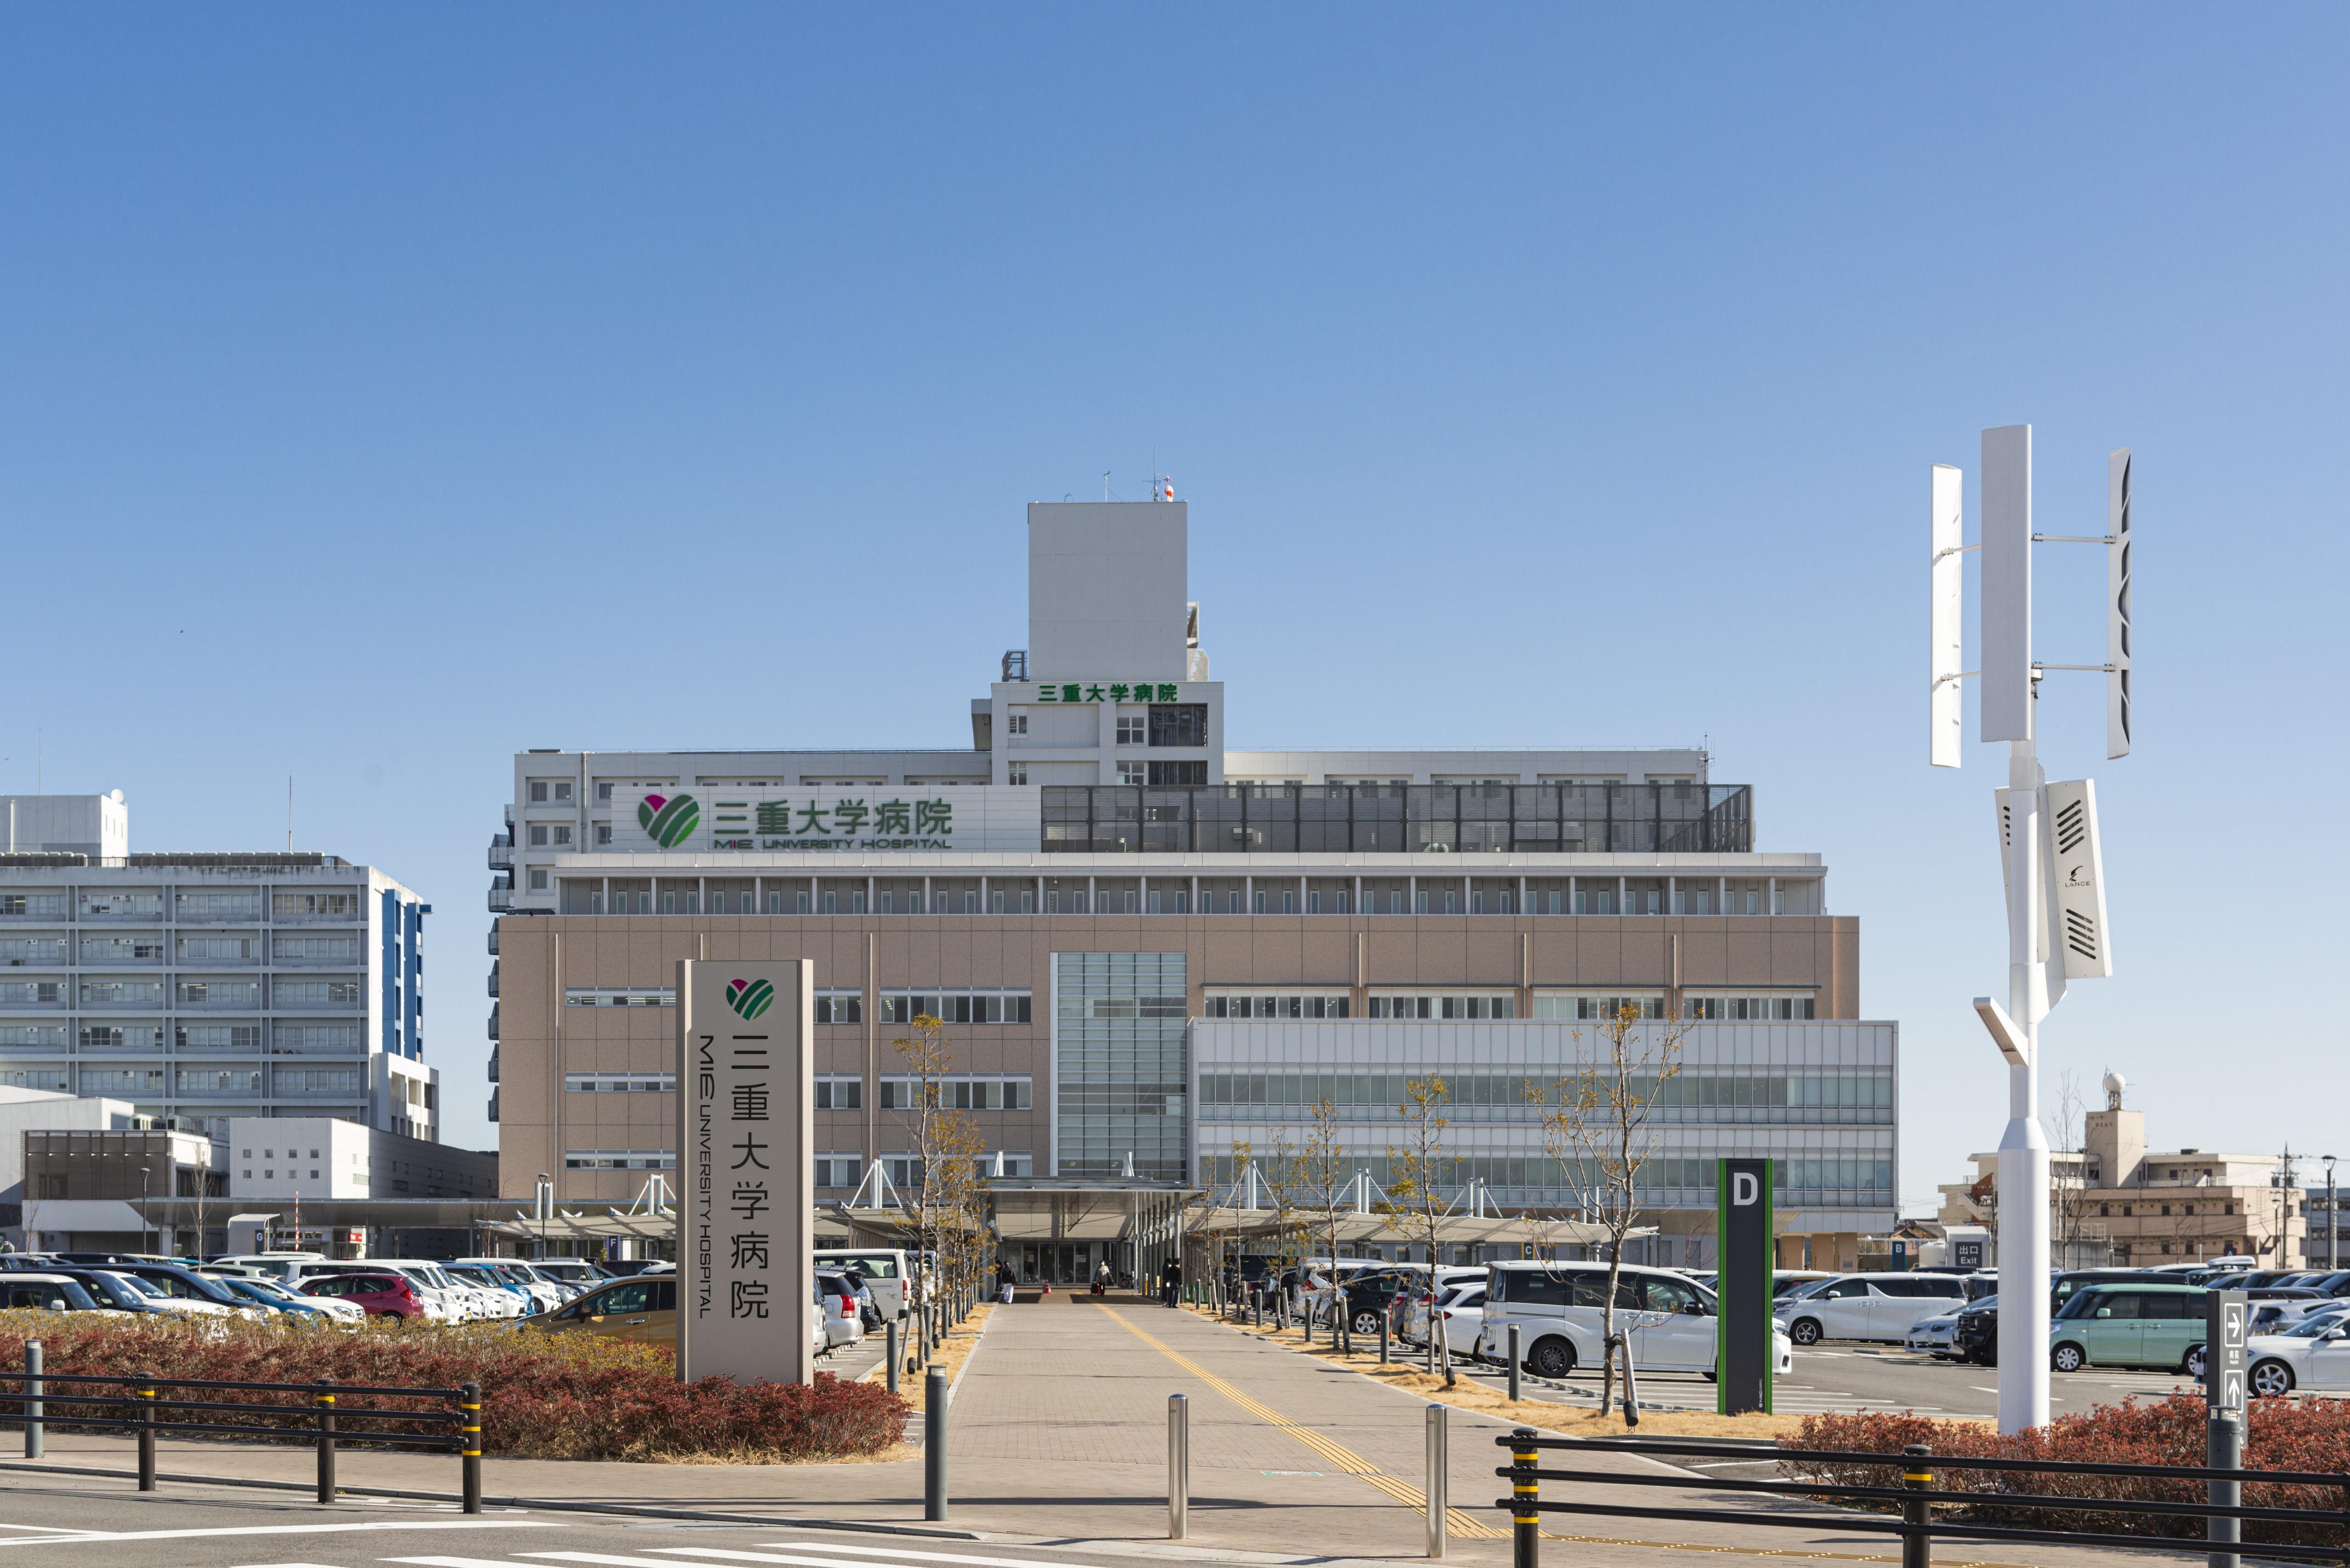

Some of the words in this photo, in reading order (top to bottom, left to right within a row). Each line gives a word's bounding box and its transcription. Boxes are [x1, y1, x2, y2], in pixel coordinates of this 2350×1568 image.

[1038, 683, 1177, 702] 三重大学病院
[714, 798, 952, 835] 三重大学病院
[714, 839, 753, 849] MIE
[763, 839, 854, 849] UNIVERSITY
[861, 839, 952, 849] HOSPITAL
[700, 1035, 715, 1100] MIE
[699, 1105, 712, 1221] UNIVERSITY
[731, 1035, 770, 1319] 三重大学病院
[1733, 1172, 1758, 1205] D
[256, 1233, 263, 1241] G
[611, 1238, 617, 1247] F
[1525, 1246, 1532, 1255] C
[1896, 1244, 1903, 1253] B
[1959, 1245, 1978, 1255] 出口
[699, 1225, 712, 1319] HOSPITAL
